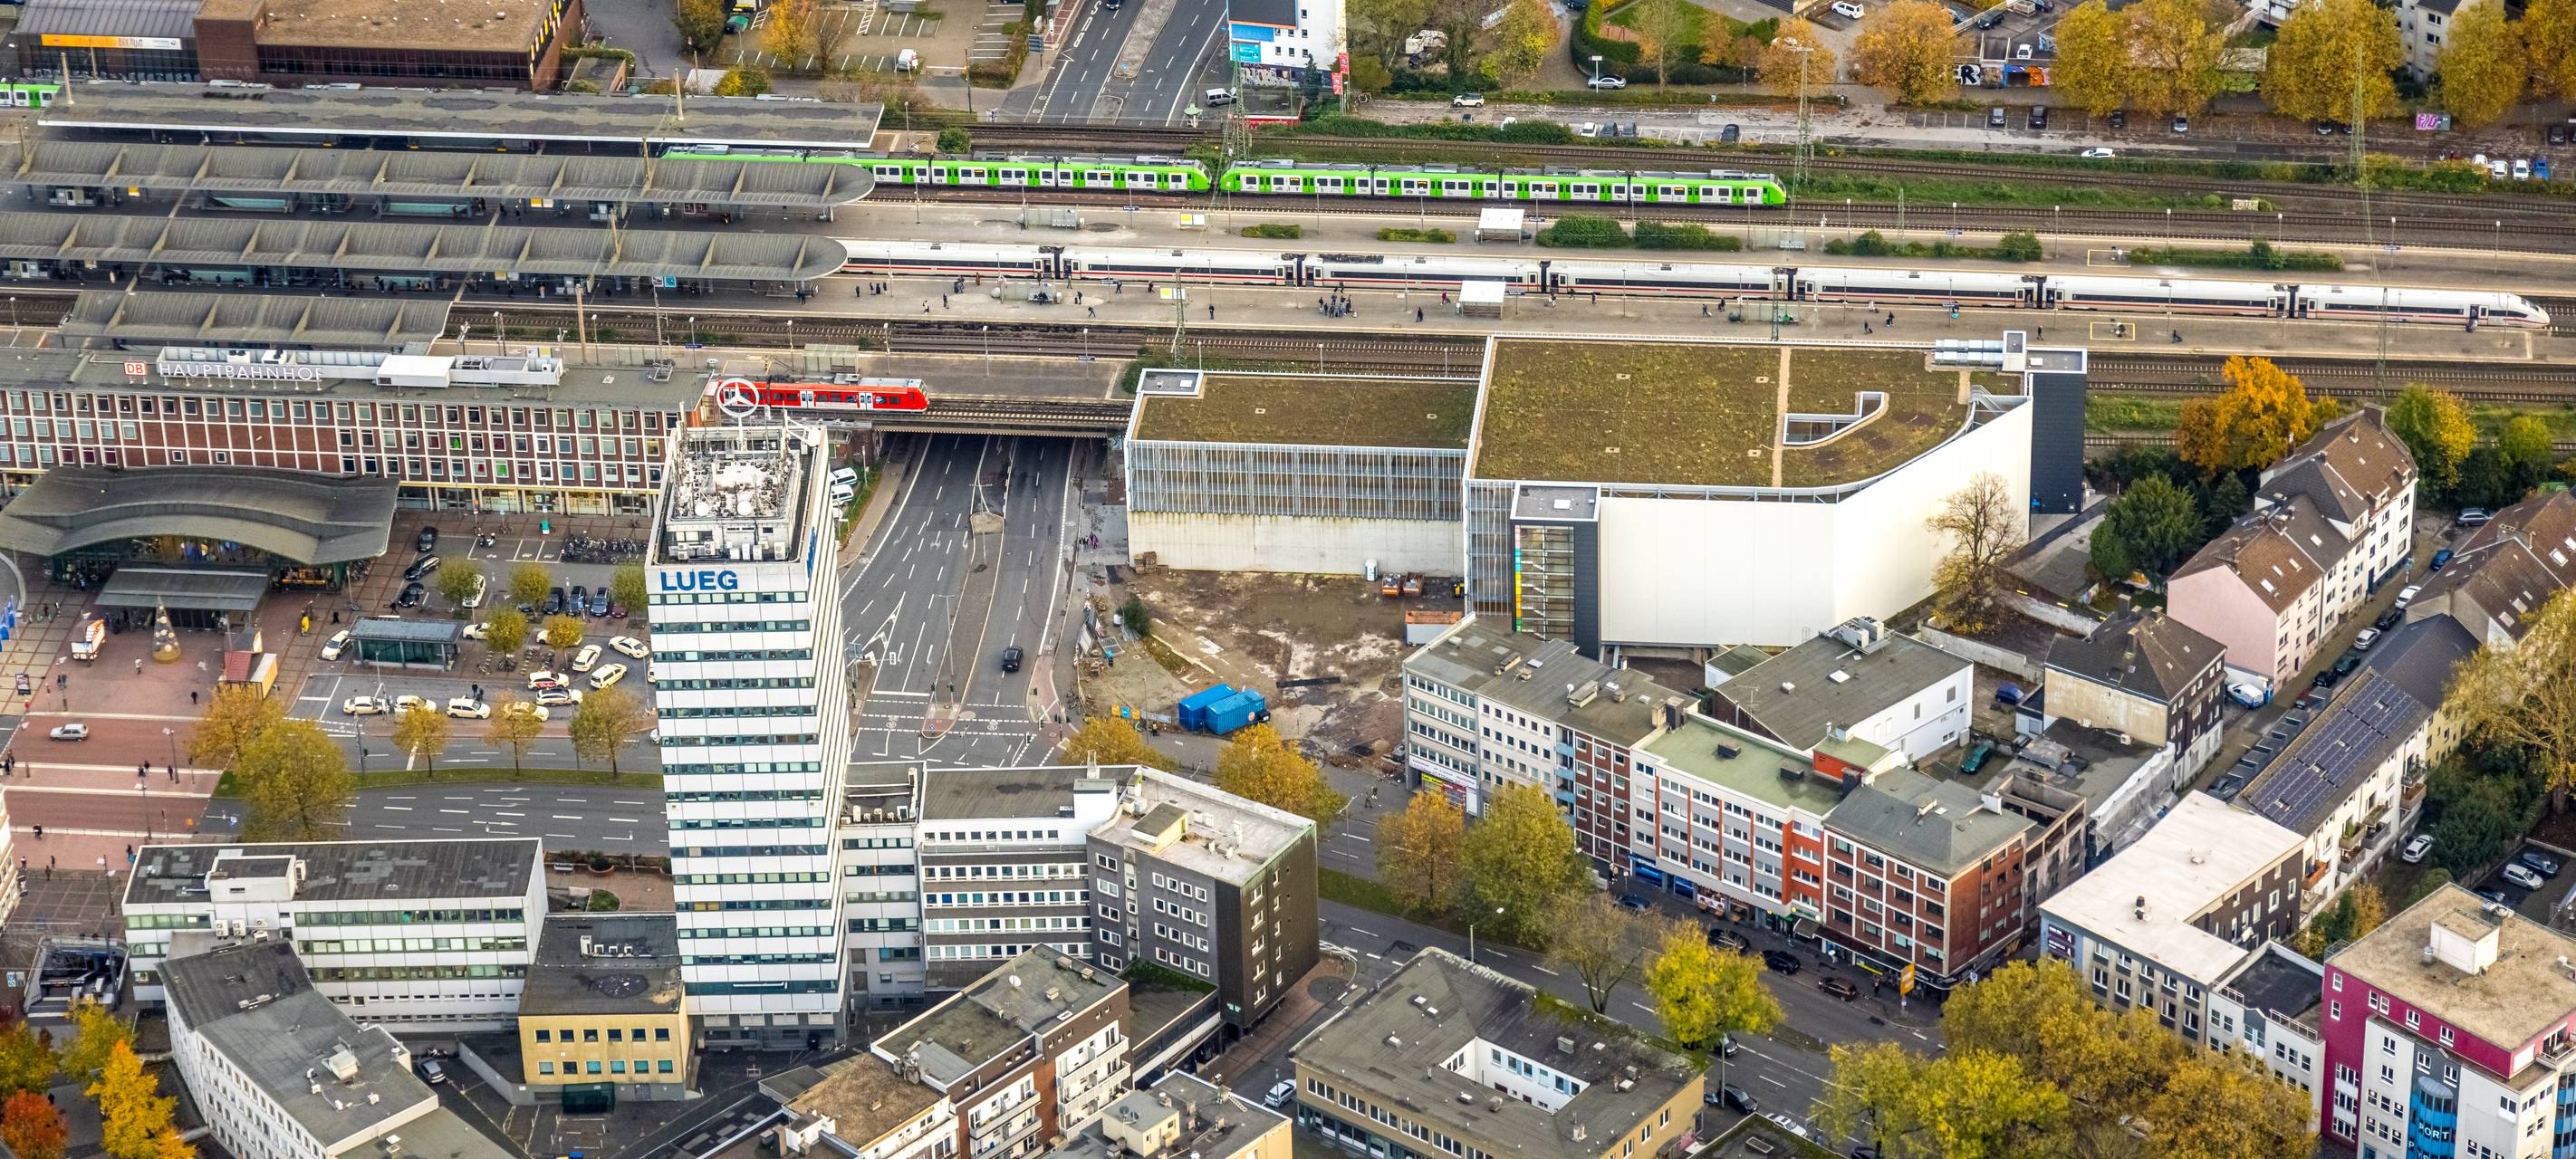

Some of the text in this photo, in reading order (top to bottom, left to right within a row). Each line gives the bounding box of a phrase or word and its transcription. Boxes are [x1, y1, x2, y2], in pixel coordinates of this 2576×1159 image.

[1073, 0, 1102, 47] BUS
[127, 362, 322, 381] DB HAUPTBAHNHOF
[660, 570, 739, 591] LUEG
